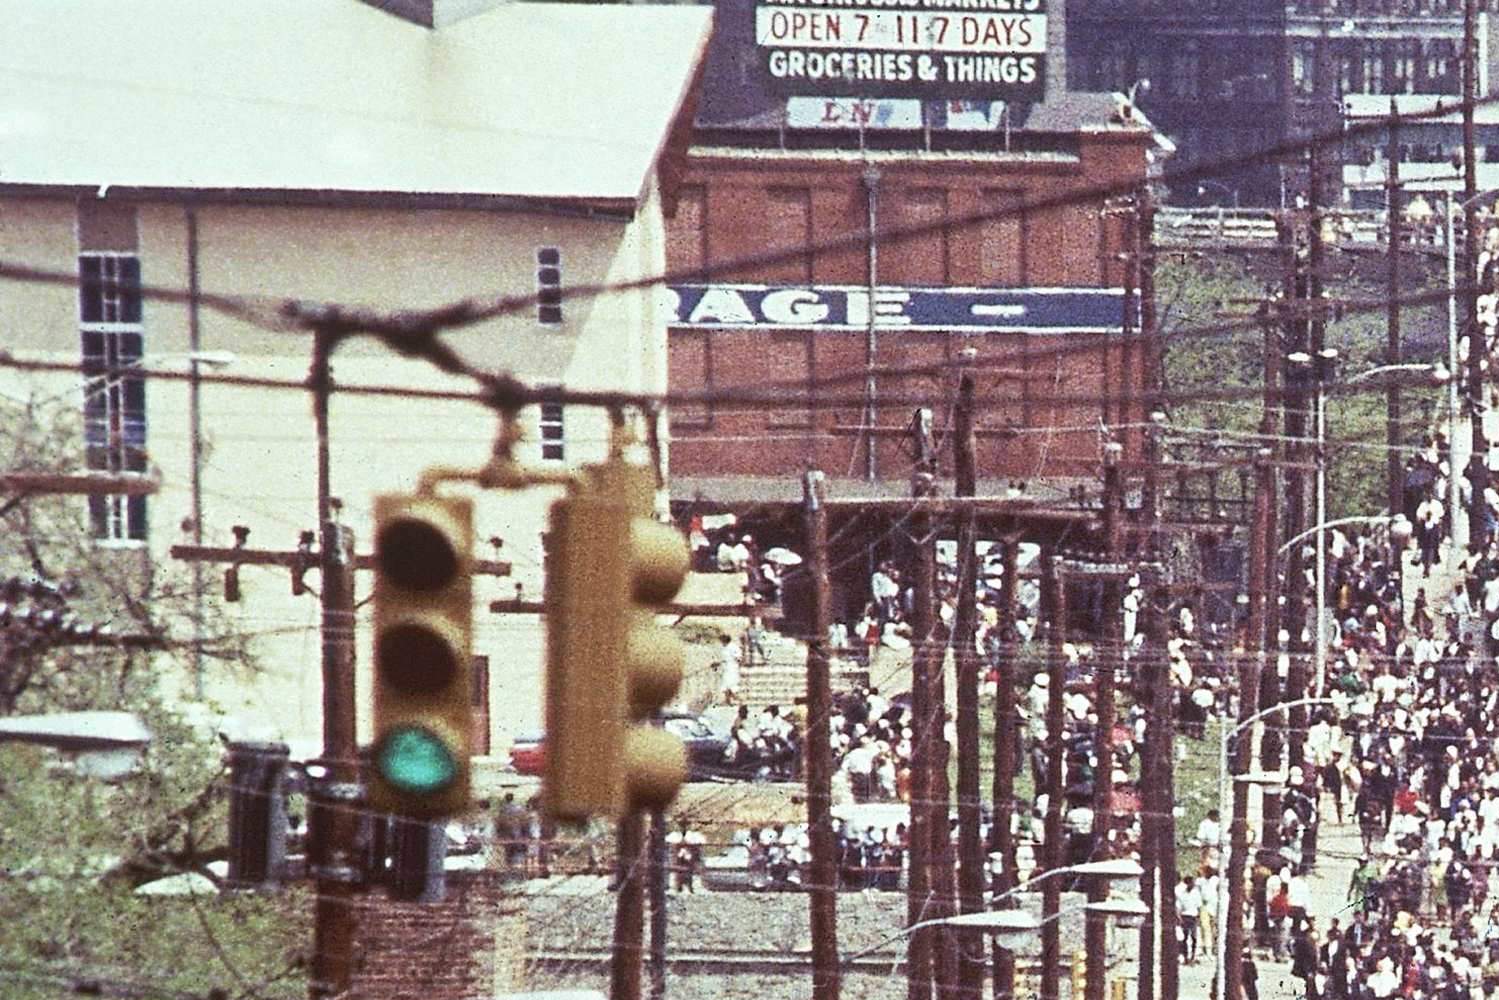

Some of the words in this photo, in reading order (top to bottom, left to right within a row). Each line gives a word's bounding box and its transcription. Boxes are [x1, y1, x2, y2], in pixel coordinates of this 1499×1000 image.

[771, 12, 841, 41] OPEN
[854, 14, 870, 42] 7
[962, 17, 1032, 46] DAYS
[769, 51, 913, 81] GROCERIES
[917, 55, 939, 81] &
[943, 55, 1037, 83] THINGS
[662, 287, 912, 325] AGE
